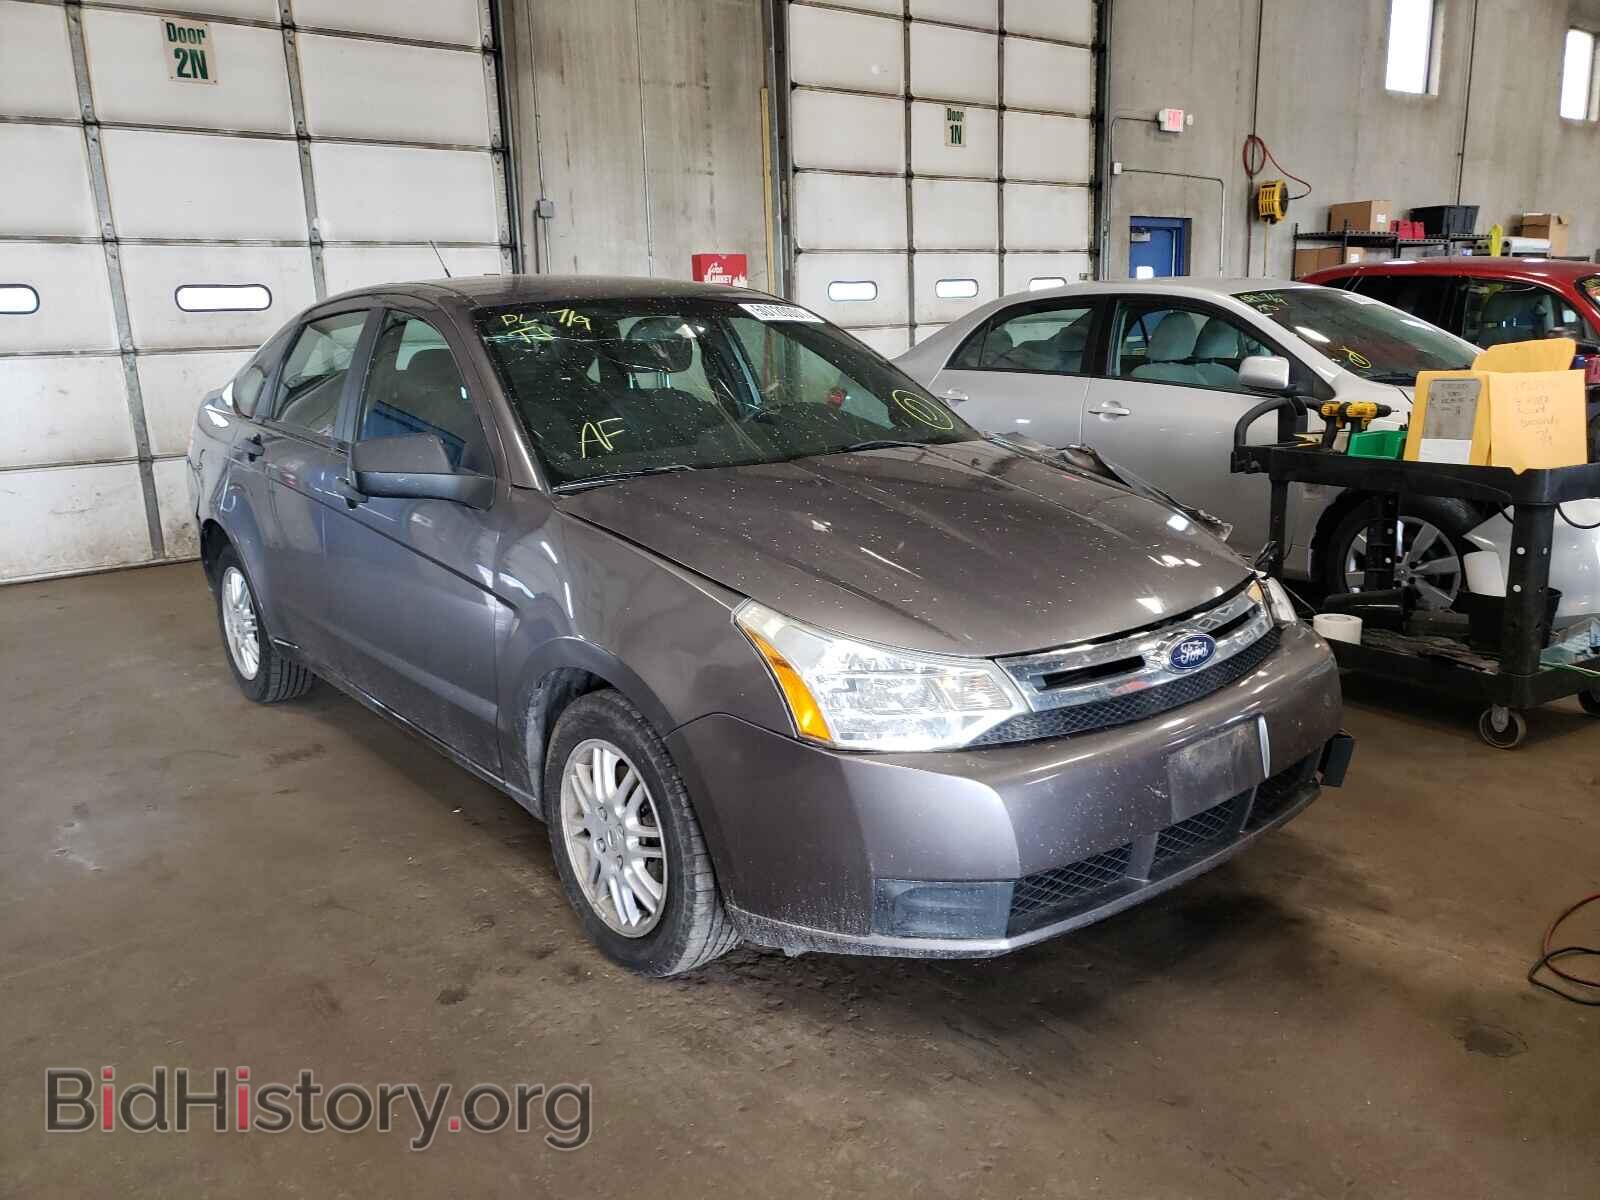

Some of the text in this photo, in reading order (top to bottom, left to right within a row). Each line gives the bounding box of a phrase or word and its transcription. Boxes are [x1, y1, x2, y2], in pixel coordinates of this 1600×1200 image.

[166, 22, 206, 45] Door
[174, 47, 208, 79] 2N
[947, 107, 964, 122] Door
[950, 124, 961, 144] 1N
[547, 308, 593, 332] 7/9
[577, 417, 625, 458] AF
[1174, 640, 1208, 664] Ford
